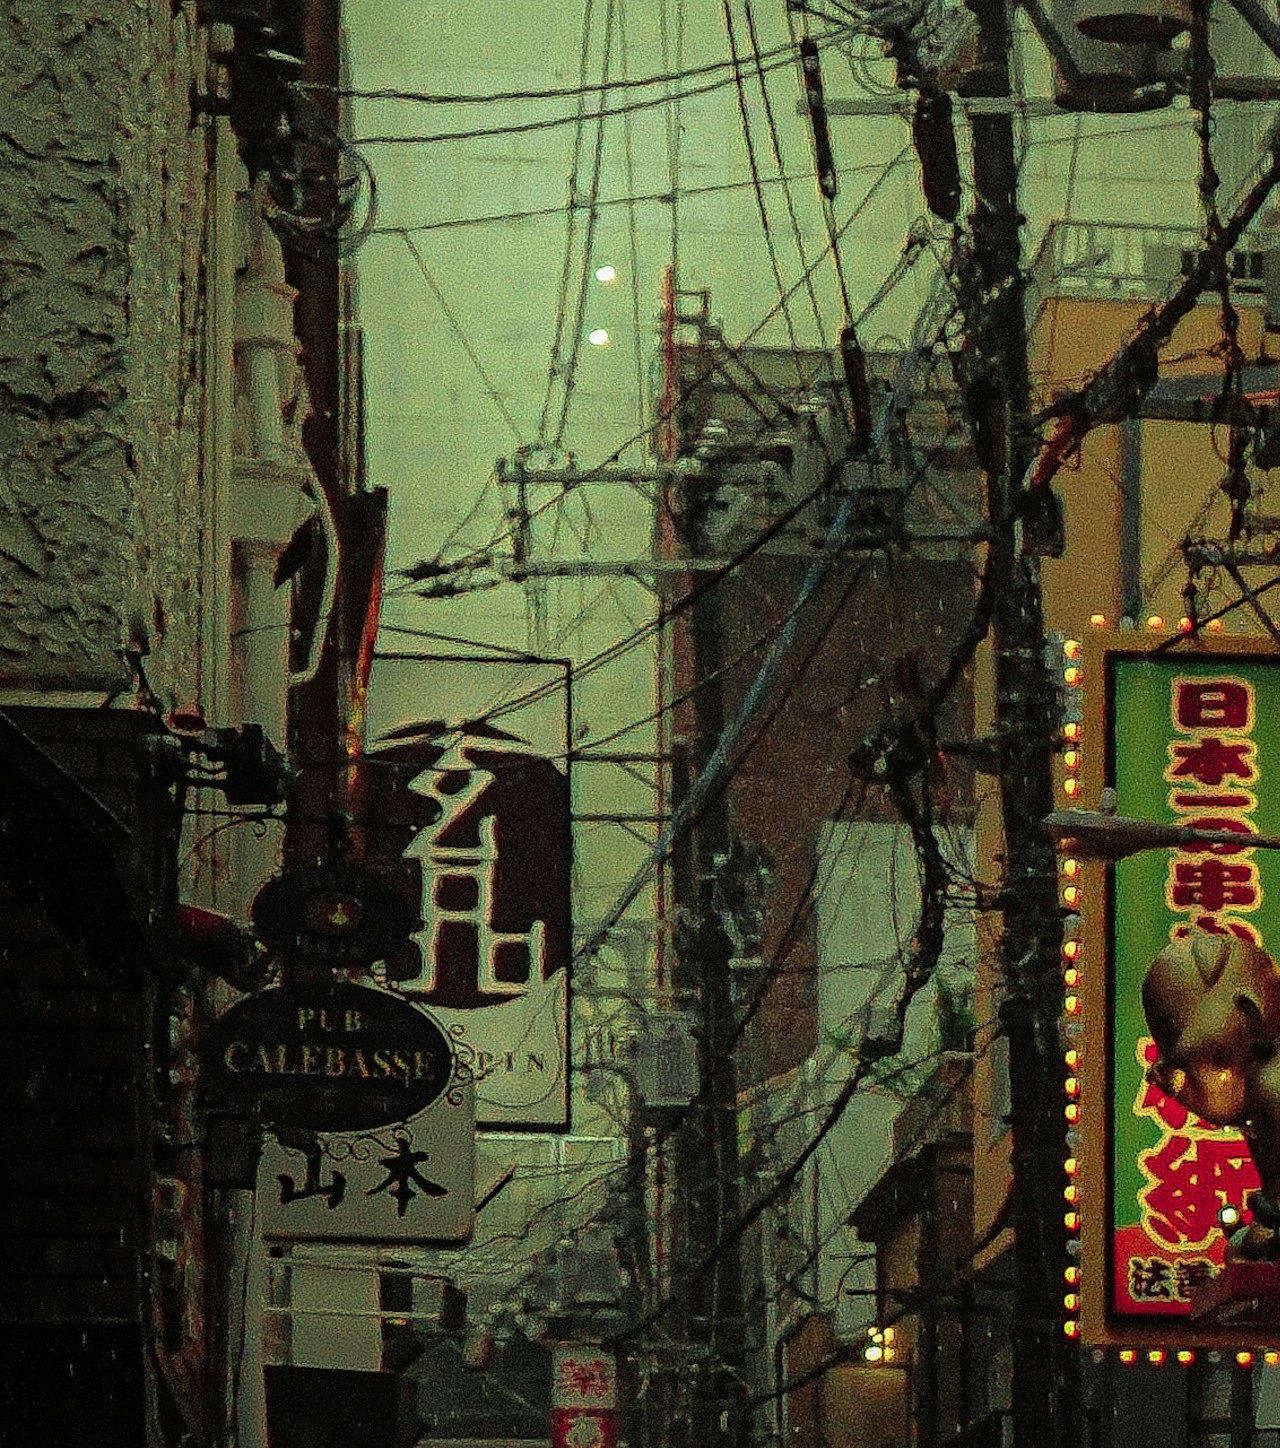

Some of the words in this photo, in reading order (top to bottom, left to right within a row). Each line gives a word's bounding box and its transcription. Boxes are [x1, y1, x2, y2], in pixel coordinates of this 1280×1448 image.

[1168, 676, 1261, 944] 日本一の串
